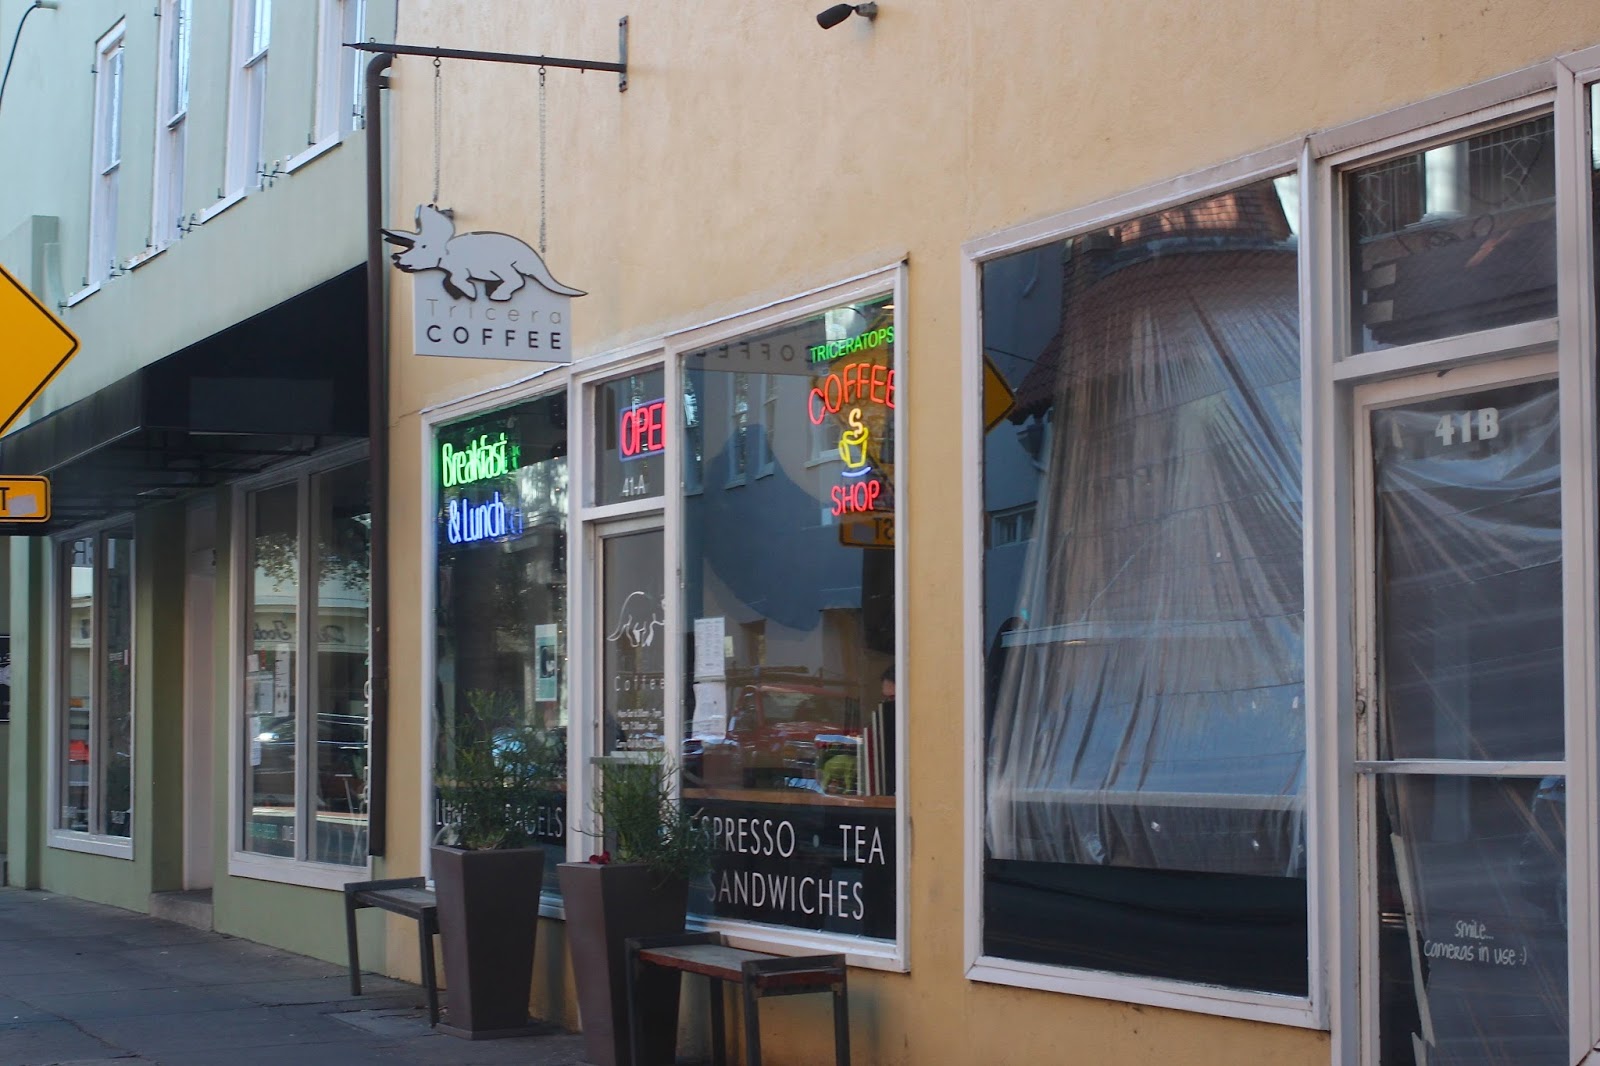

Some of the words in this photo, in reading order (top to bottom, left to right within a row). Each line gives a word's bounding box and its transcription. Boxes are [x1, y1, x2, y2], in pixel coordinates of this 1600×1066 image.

[426, 299, 561, 325] Tricera
[427, 324, 561, 350] COFFEE
[810, 326, 894, 363] TRICERATOPS
[808, 363, 895, 425] COFFEE
[1435, 407, 1499, 446] 41B
[442, 432, 508, 488] Breakfast
[831, 480, 880, 516] SHOP
[839, 824, 885, 865] TEA
[1478, 942, 1489, 962] in
